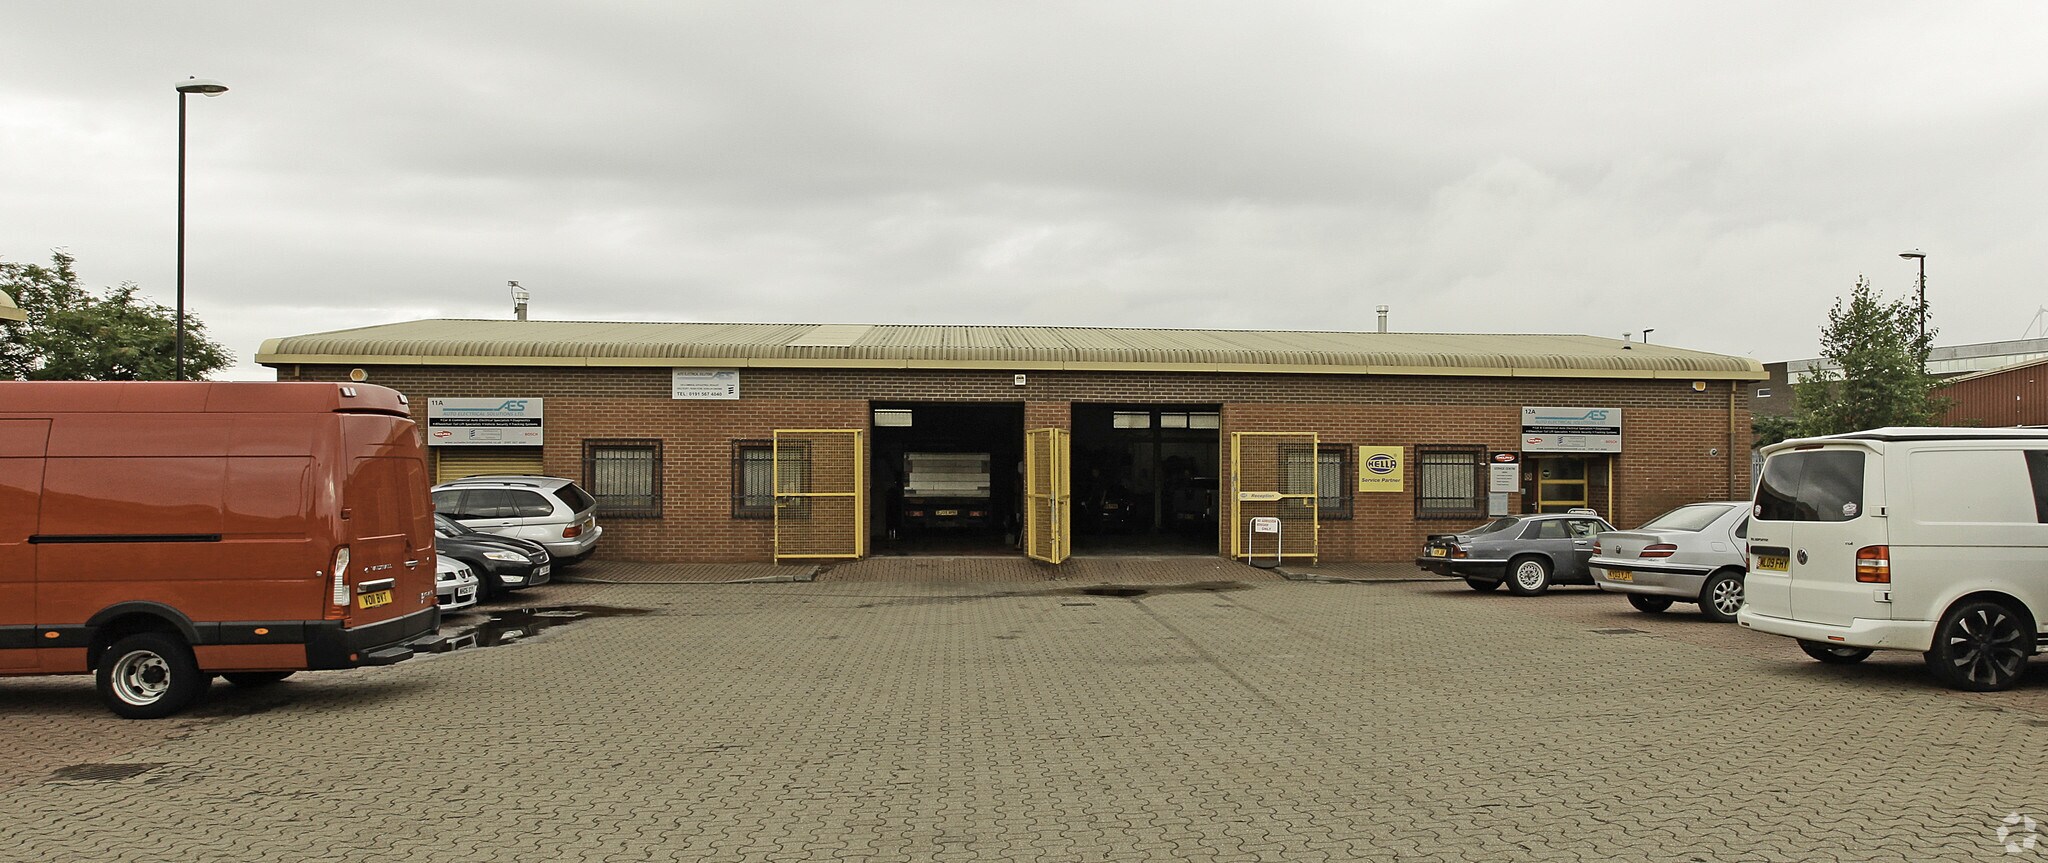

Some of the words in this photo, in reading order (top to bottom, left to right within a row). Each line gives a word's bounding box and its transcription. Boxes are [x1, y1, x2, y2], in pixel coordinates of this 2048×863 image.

[499, 400, 528, 411] AES
[1584, 410, 1609, 420] AES
[1368, 459, 1396, 469] HELLA
[377, 592, 387, 603] BVT
